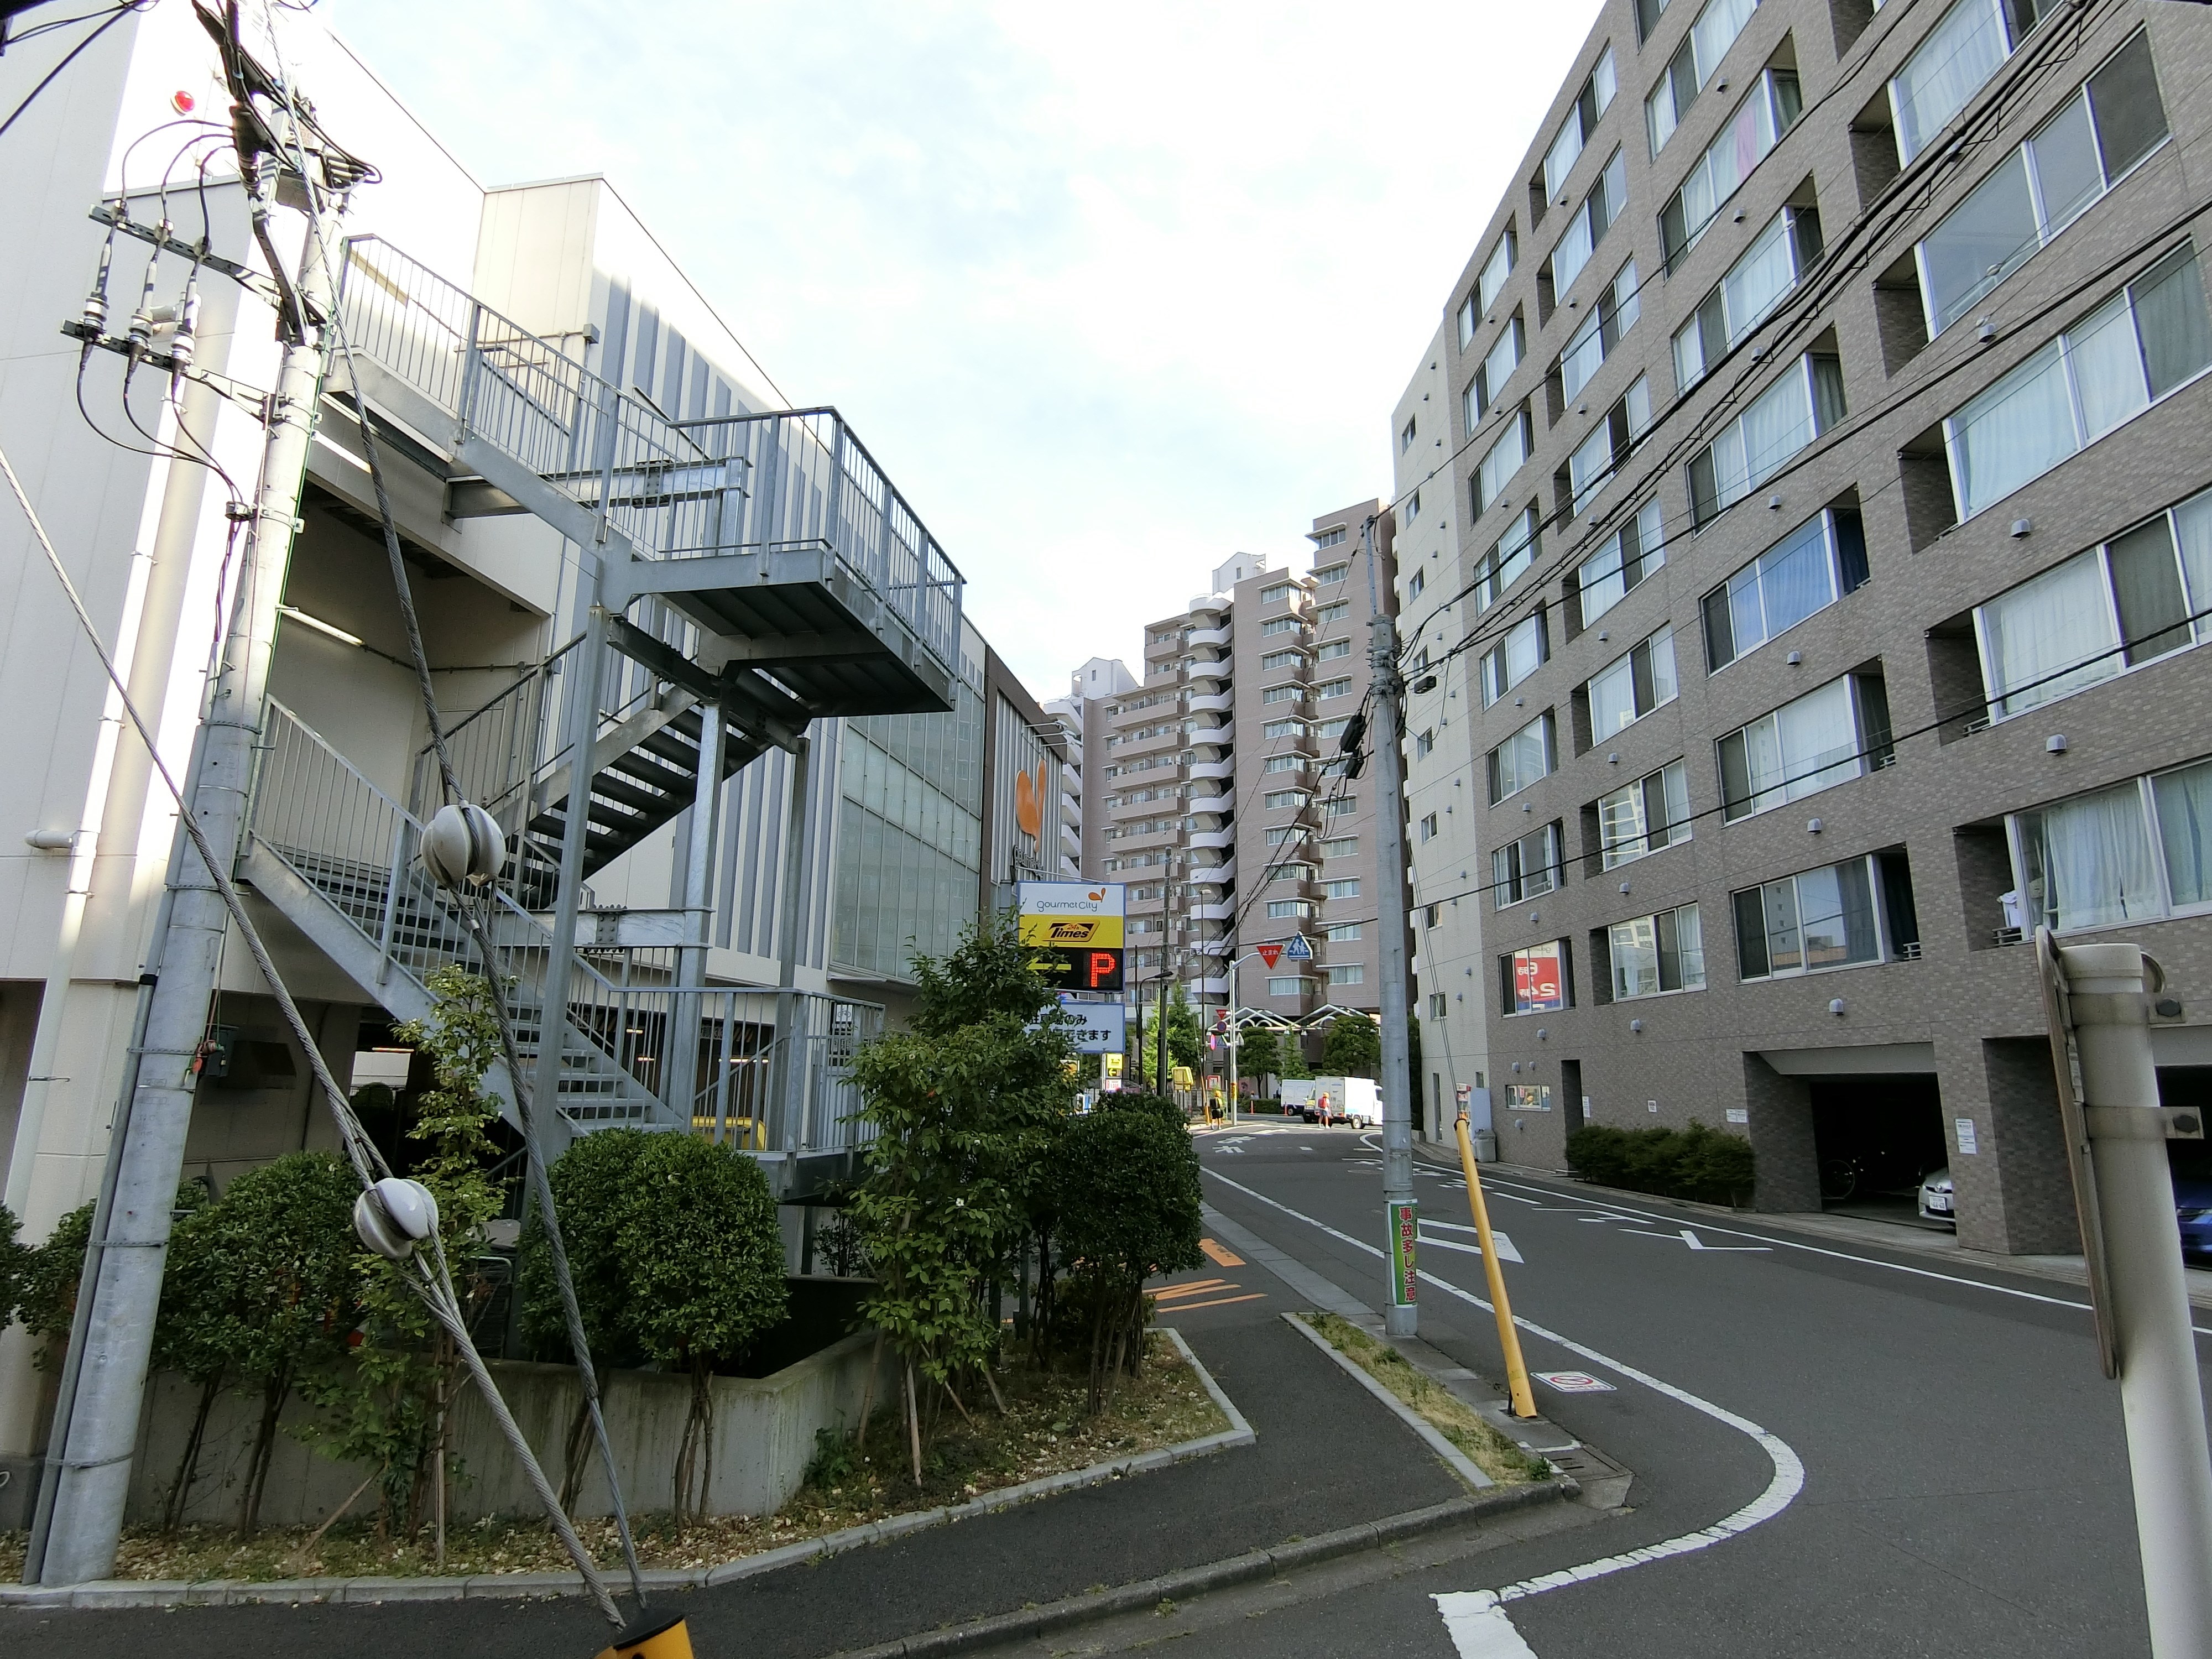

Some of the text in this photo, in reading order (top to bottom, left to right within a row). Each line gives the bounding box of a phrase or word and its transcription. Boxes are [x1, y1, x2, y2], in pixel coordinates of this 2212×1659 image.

[1050, 925, 1091, 938] Times
[1262, 947, 1279, 956] 止まれ
[1091, 952, 1116, 988] P
[1399, 1206, 1416, 1301] 事故多し注意
